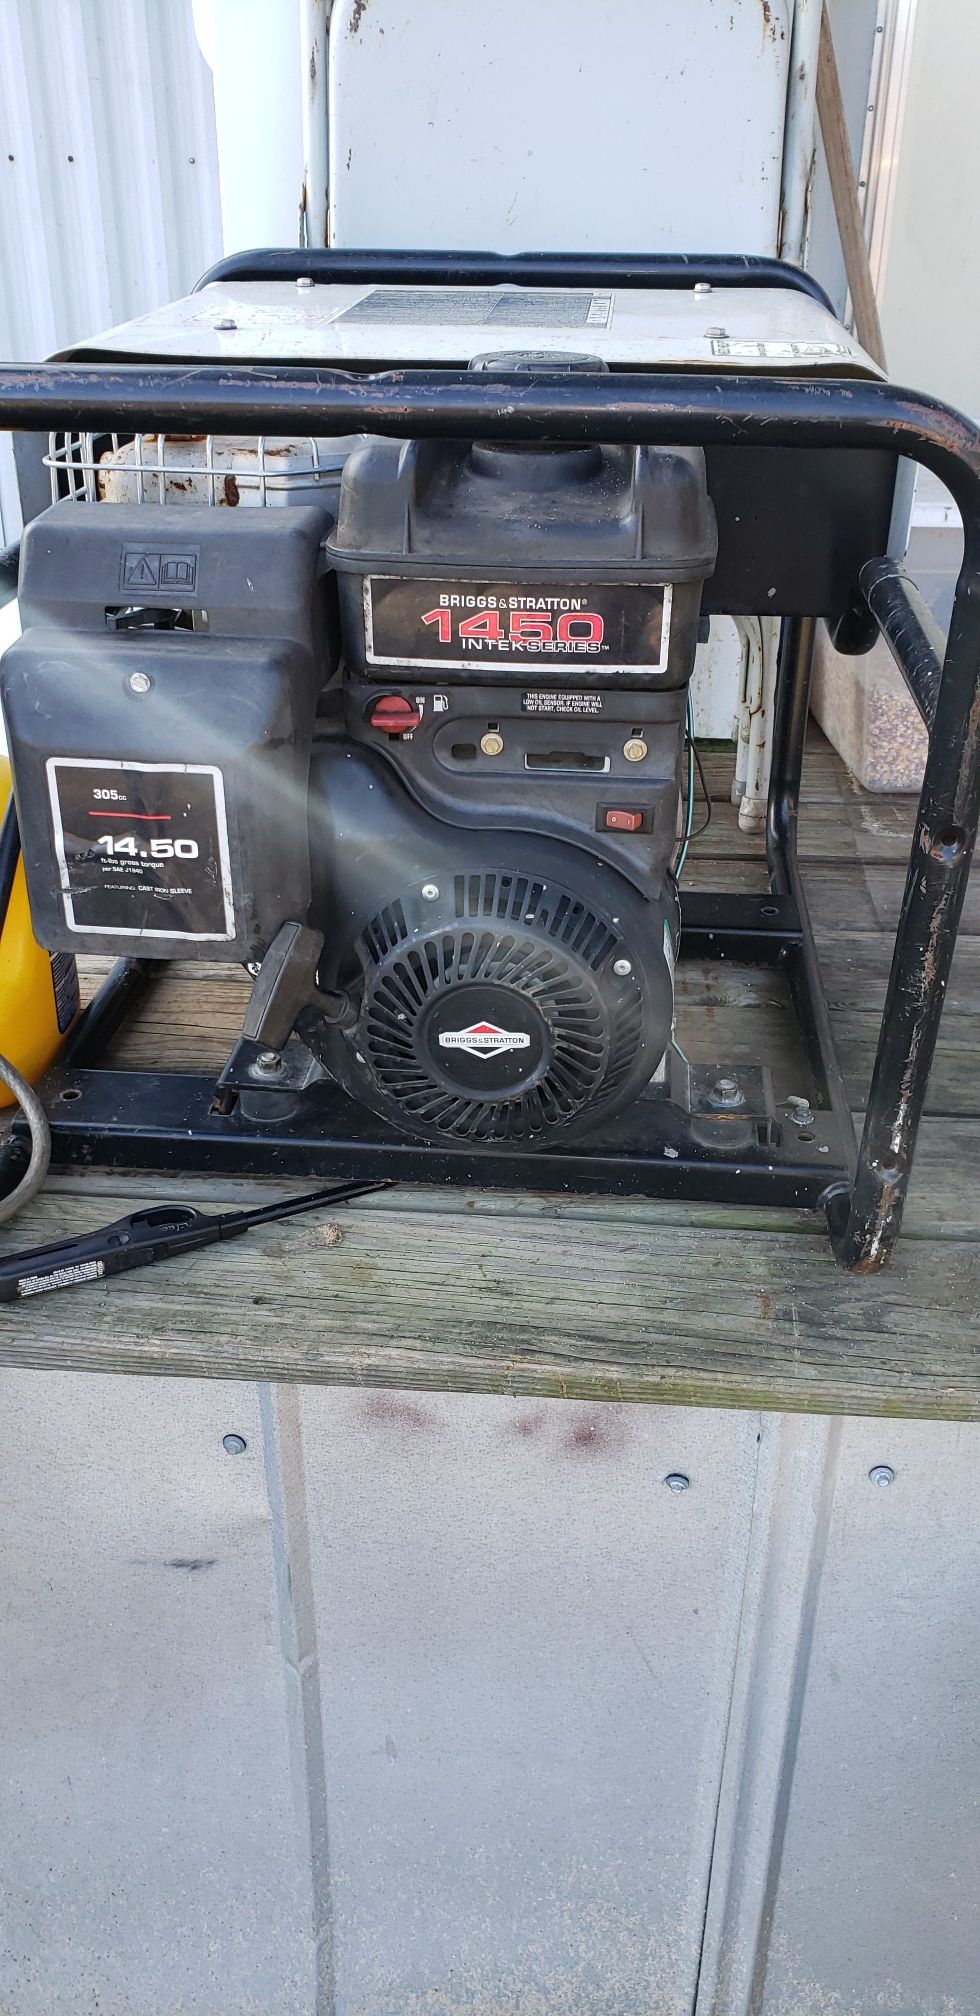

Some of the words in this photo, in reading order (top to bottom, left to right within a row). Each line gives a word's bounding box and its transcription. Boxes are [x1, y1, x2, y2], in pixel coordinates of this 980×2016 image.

[421, 608, 605, 644] 1450
[415, 696, 426, 704] ON
[97, 835, 199, 859] 14.50
[141, 861, 164, 869] torque
